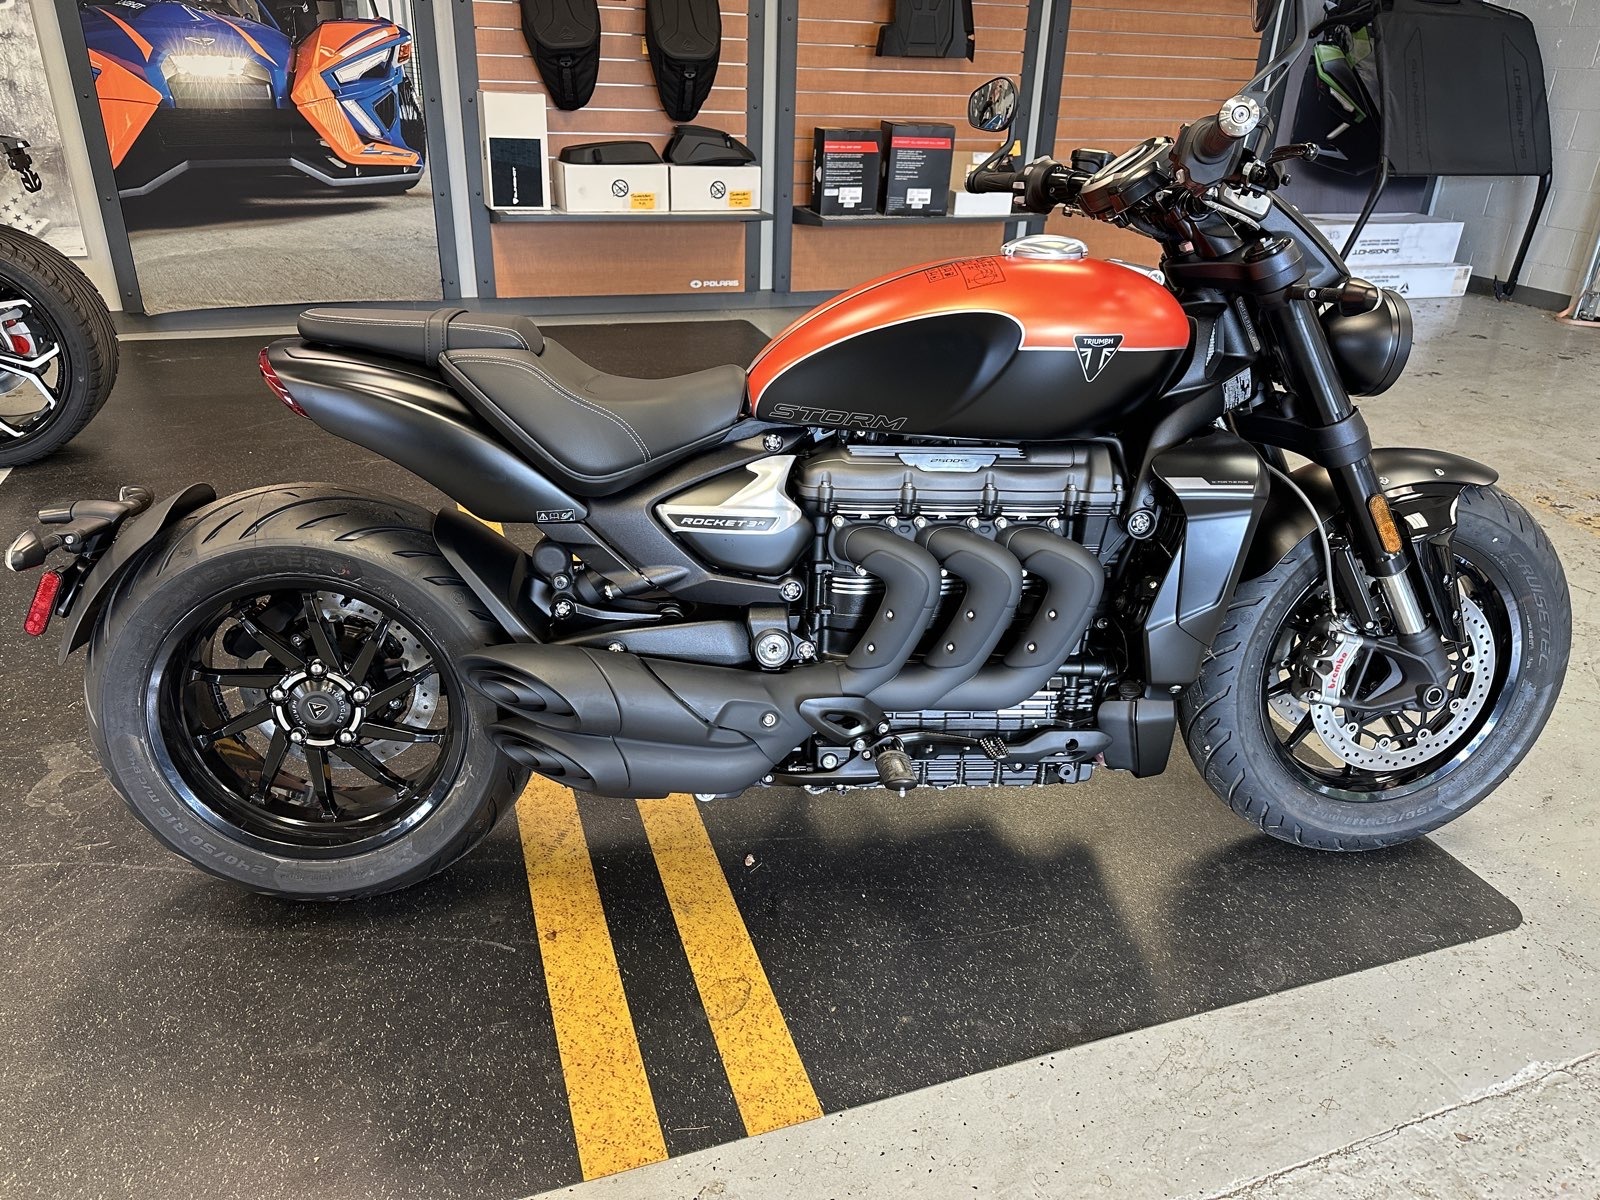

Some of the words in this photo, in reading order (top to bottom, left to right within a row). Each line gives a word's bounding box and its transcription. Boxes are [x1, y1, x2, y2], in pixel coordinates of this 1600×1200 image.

[1352, 248, 1400, 256] SLINGSHOT
[1083, 338, 1114, 347] TRIUMPH
[768, 403, 908, 431] STORM
[1509, 552, 1552, 671] CRUISETEC
[1327, 652, 1347, 689] brembo
[292, 700, 307, 727] TRIUMPH
[322, 685, 346, 723] MOTORCYCLES
[156, 806, 189, 834] R16
[189, 835, 268, 875] 240/50
